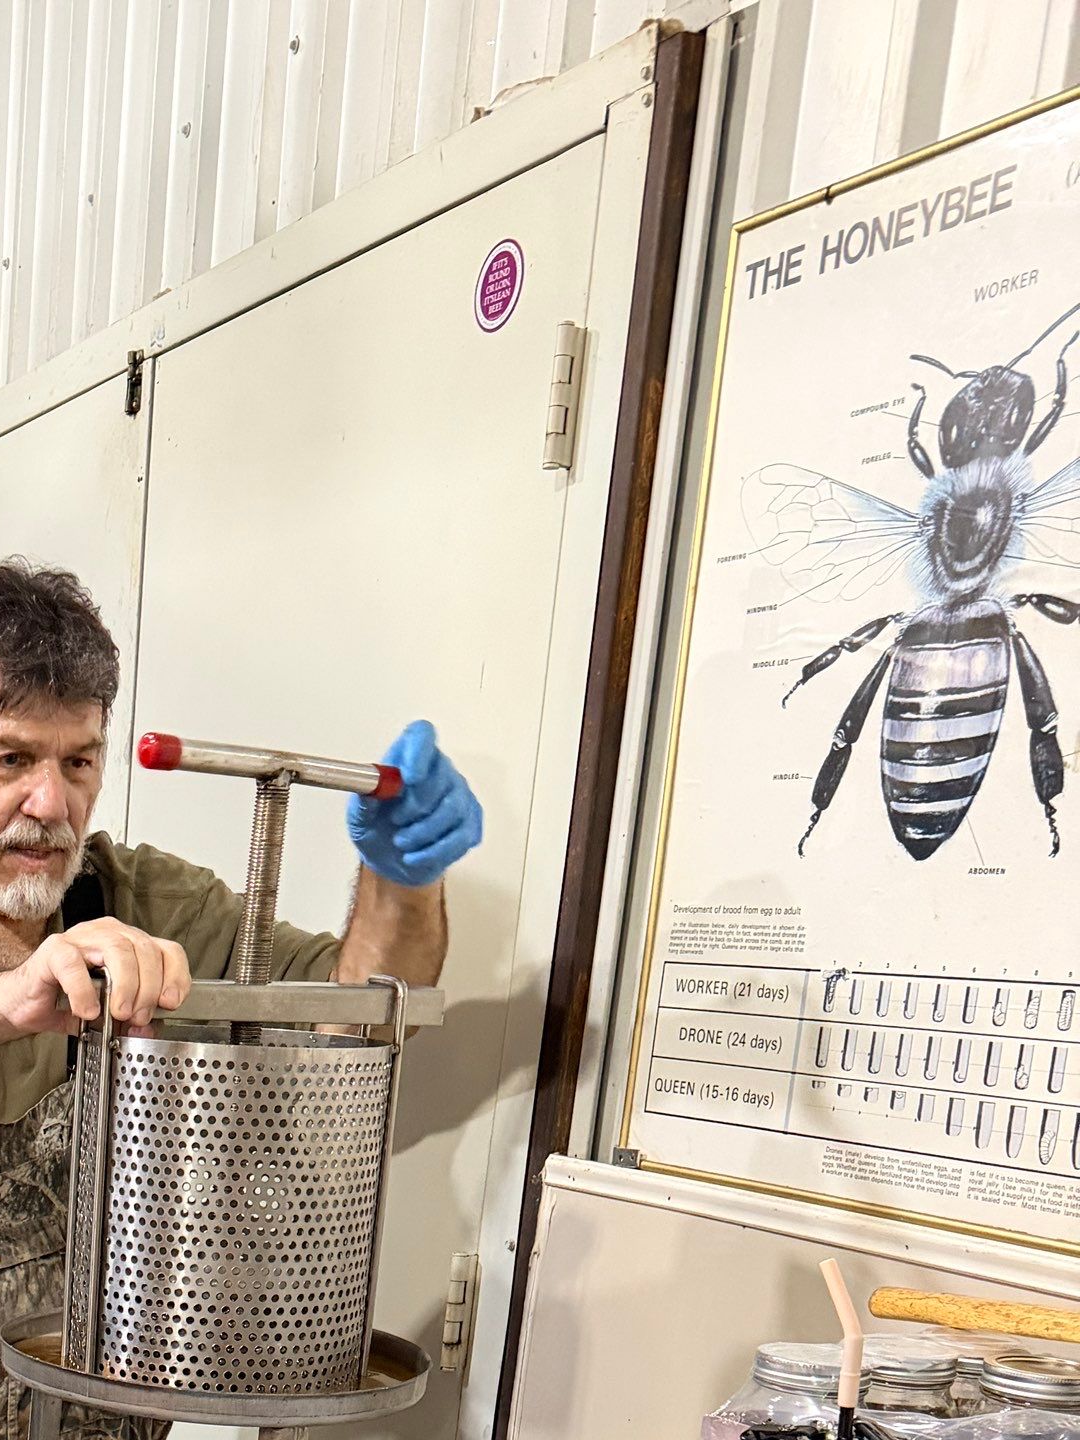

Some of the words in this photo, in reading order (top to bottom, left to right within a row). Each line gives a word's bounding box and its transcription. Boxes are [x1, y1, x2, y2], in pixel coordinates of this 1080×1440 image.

[745, 243, 806, 300] THE
[818, 163, 1018, 275] HONEYBEE
[974, 269, 1039, 303] WORKER
[968, 866, 1006, 875] ABDOMEN
[673, 904, 712, 914] Development
[714, 904, 722, 914] of
[722, 905, 742, 914] brood
[743, 905, 759, 914] from
[760, 907, 773, 916] egg
[774, 907, 782, 915] to
[783, 906, 802, 915] adult
[676, 978, 728, 996] WORKER
[733, 982, 751, 999] (21
[757, 984, 789, 1003] days)
[679, 1027, 723, 1045] DRONE
[727, 1031, 746, 1049] (24
[750, 1034, 783, 1054] days)
[655, 1078, 695, 1096] QUEEN
[699, 1083, 739, 1102] (15-16
[743, 1089, 775, 1109] days)
